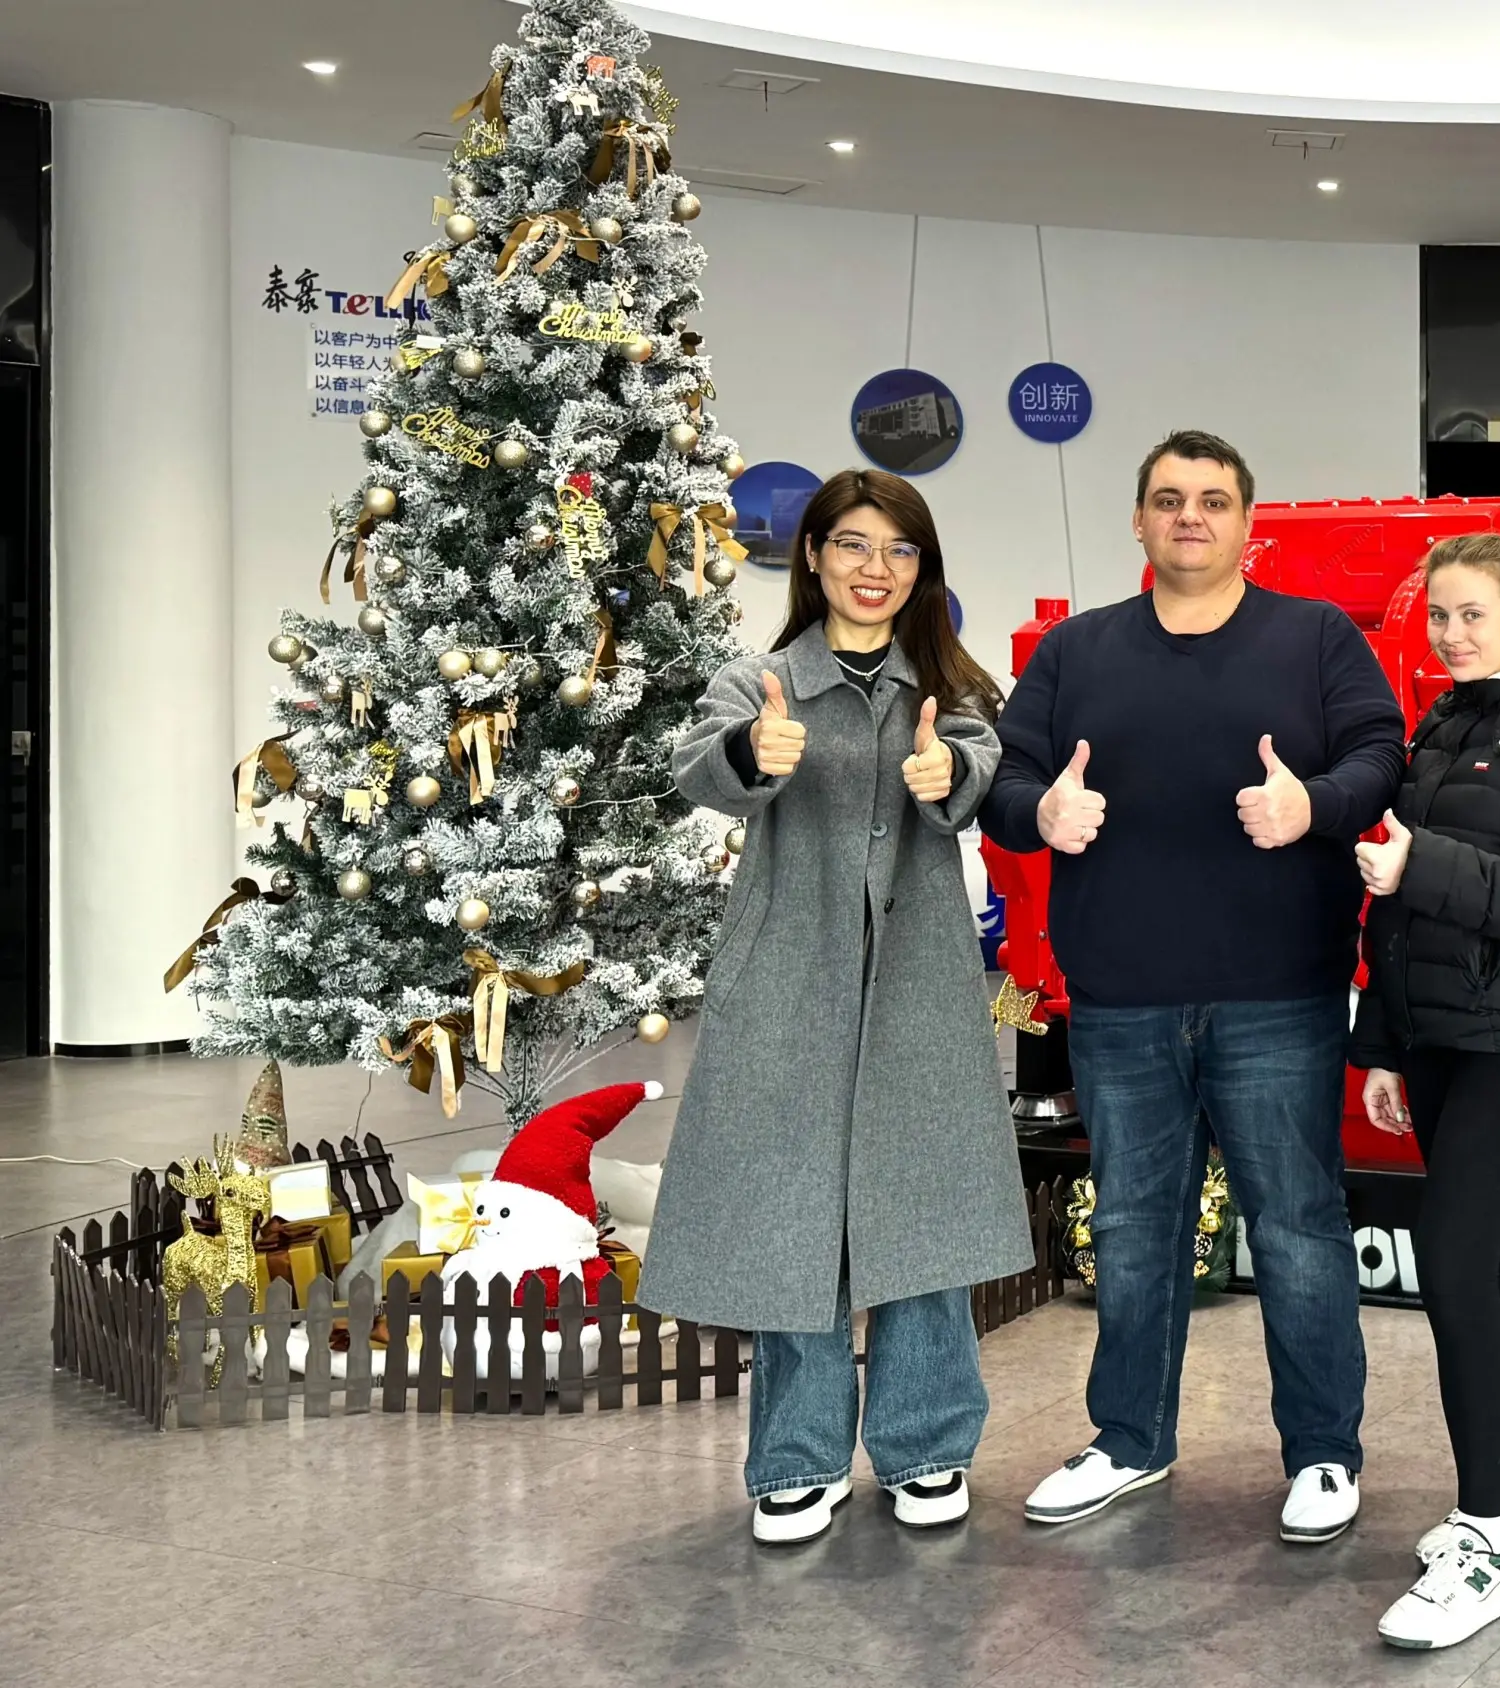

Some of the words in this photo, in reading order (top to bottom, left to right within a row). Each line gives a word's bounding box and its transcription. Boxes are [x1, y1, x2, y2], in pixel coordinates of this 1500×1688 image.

[262, 264, 321, 314] 泰豪
[315, 375, 377, 393] 以奋斗
[1019, 382, 1080, 411] 创新
[1024, 414, 1079, 423] INNOVATE
